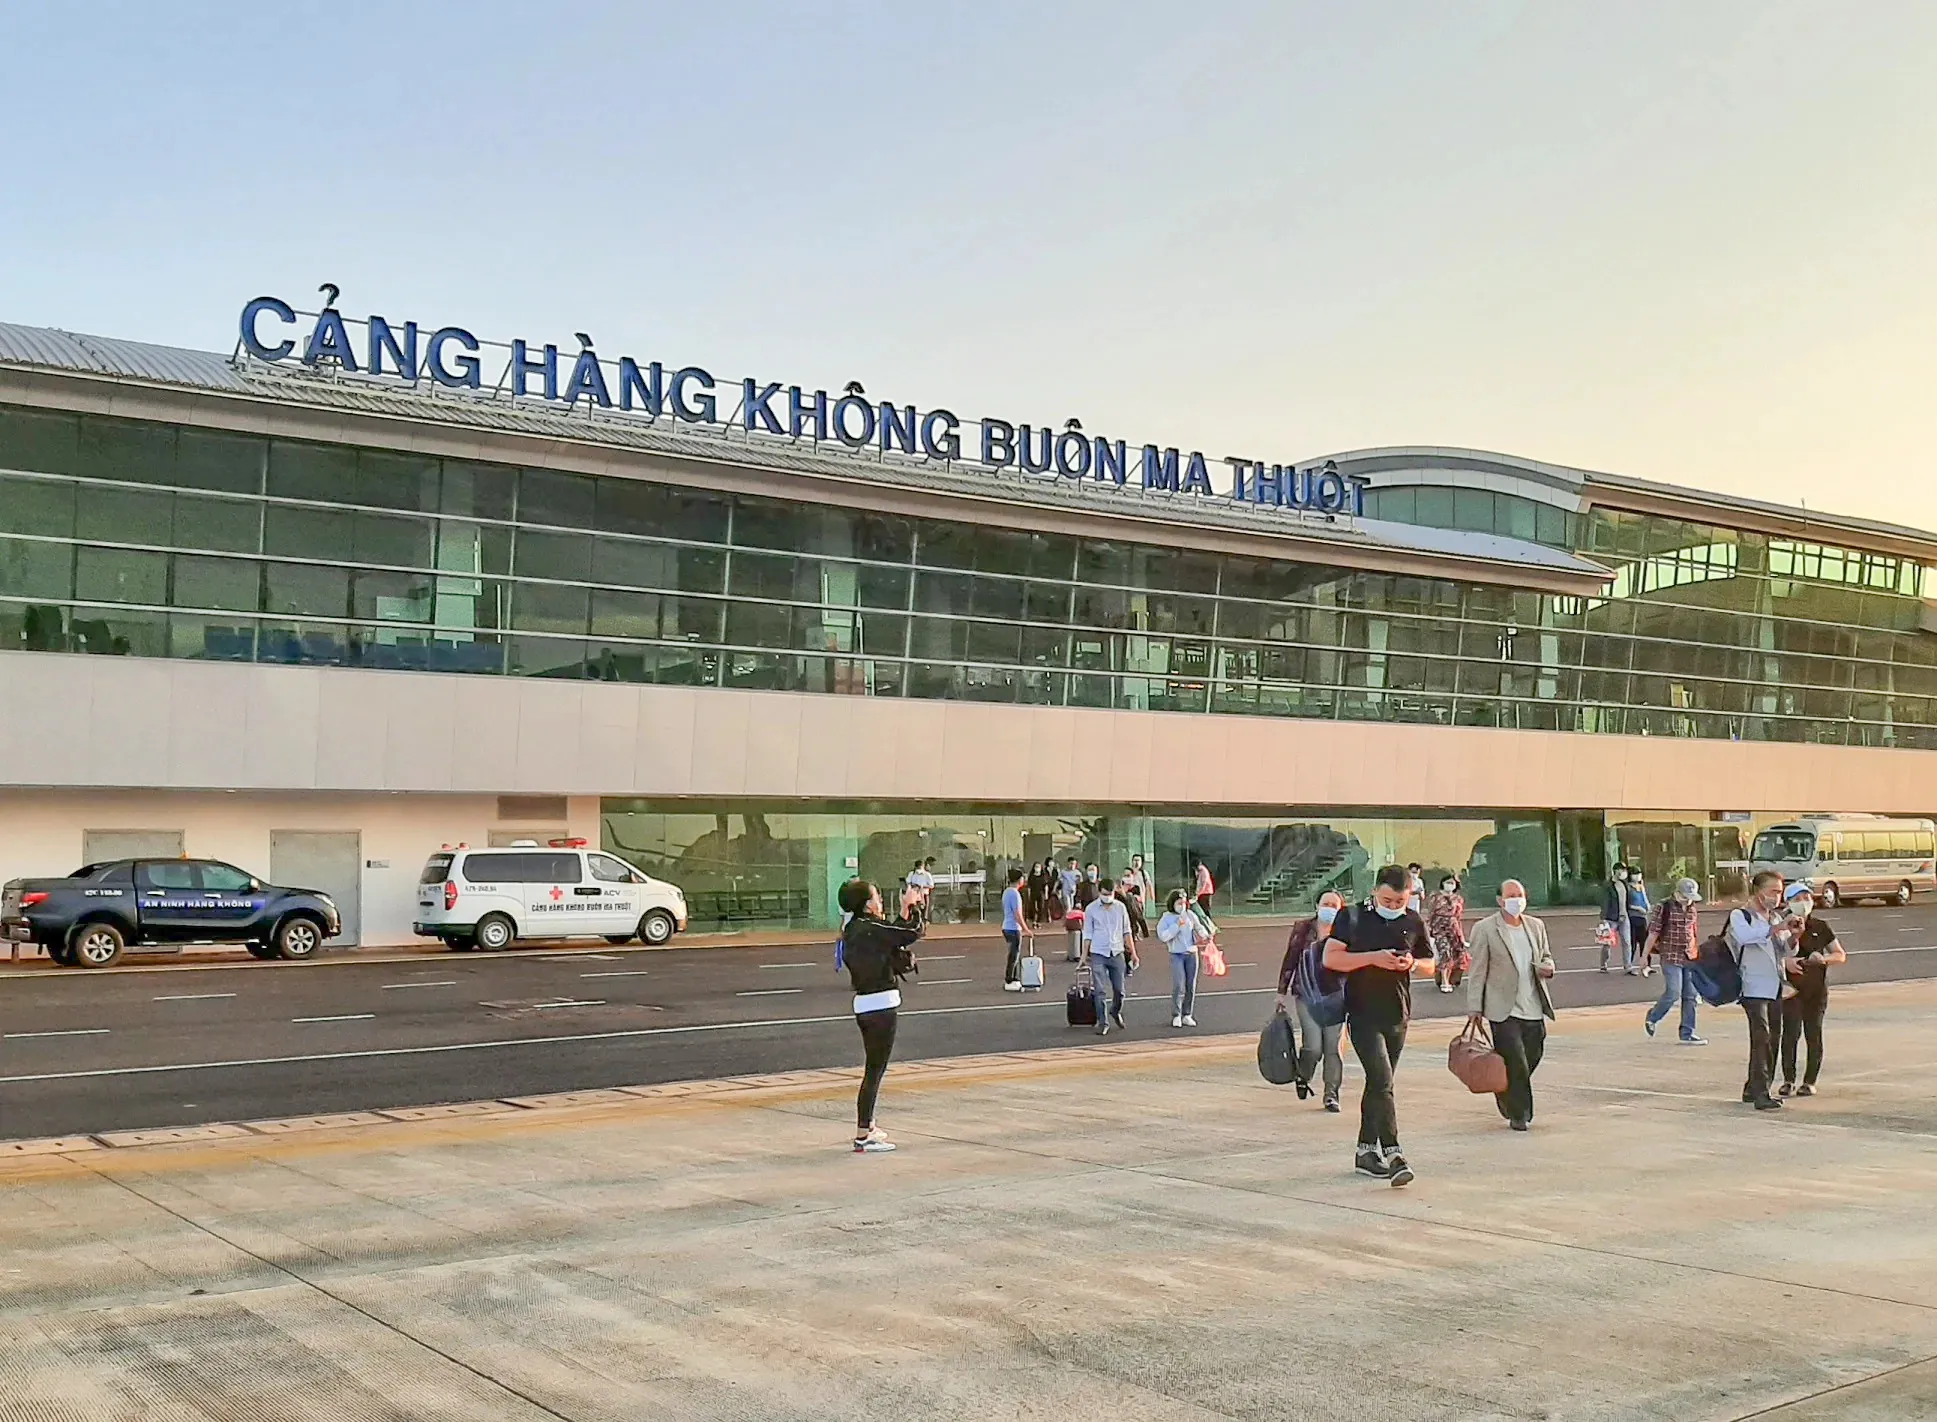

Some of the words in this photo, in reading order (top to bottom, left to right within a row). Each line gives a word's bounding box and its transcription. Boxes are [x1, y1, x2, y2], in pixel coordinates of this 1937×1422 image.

[239, 283, 481, 389] CẢNG
[512, 332, 716, 424] HÀNG
[743, 378, 961, 461] KHÔNG
[981, 417, 1126, 486] BUÔN
[1143, 443, 1214, 496] MA
[1223, 456, 1371, 522] THUỘT
[217, 899, 252, 908] KHÔNG
